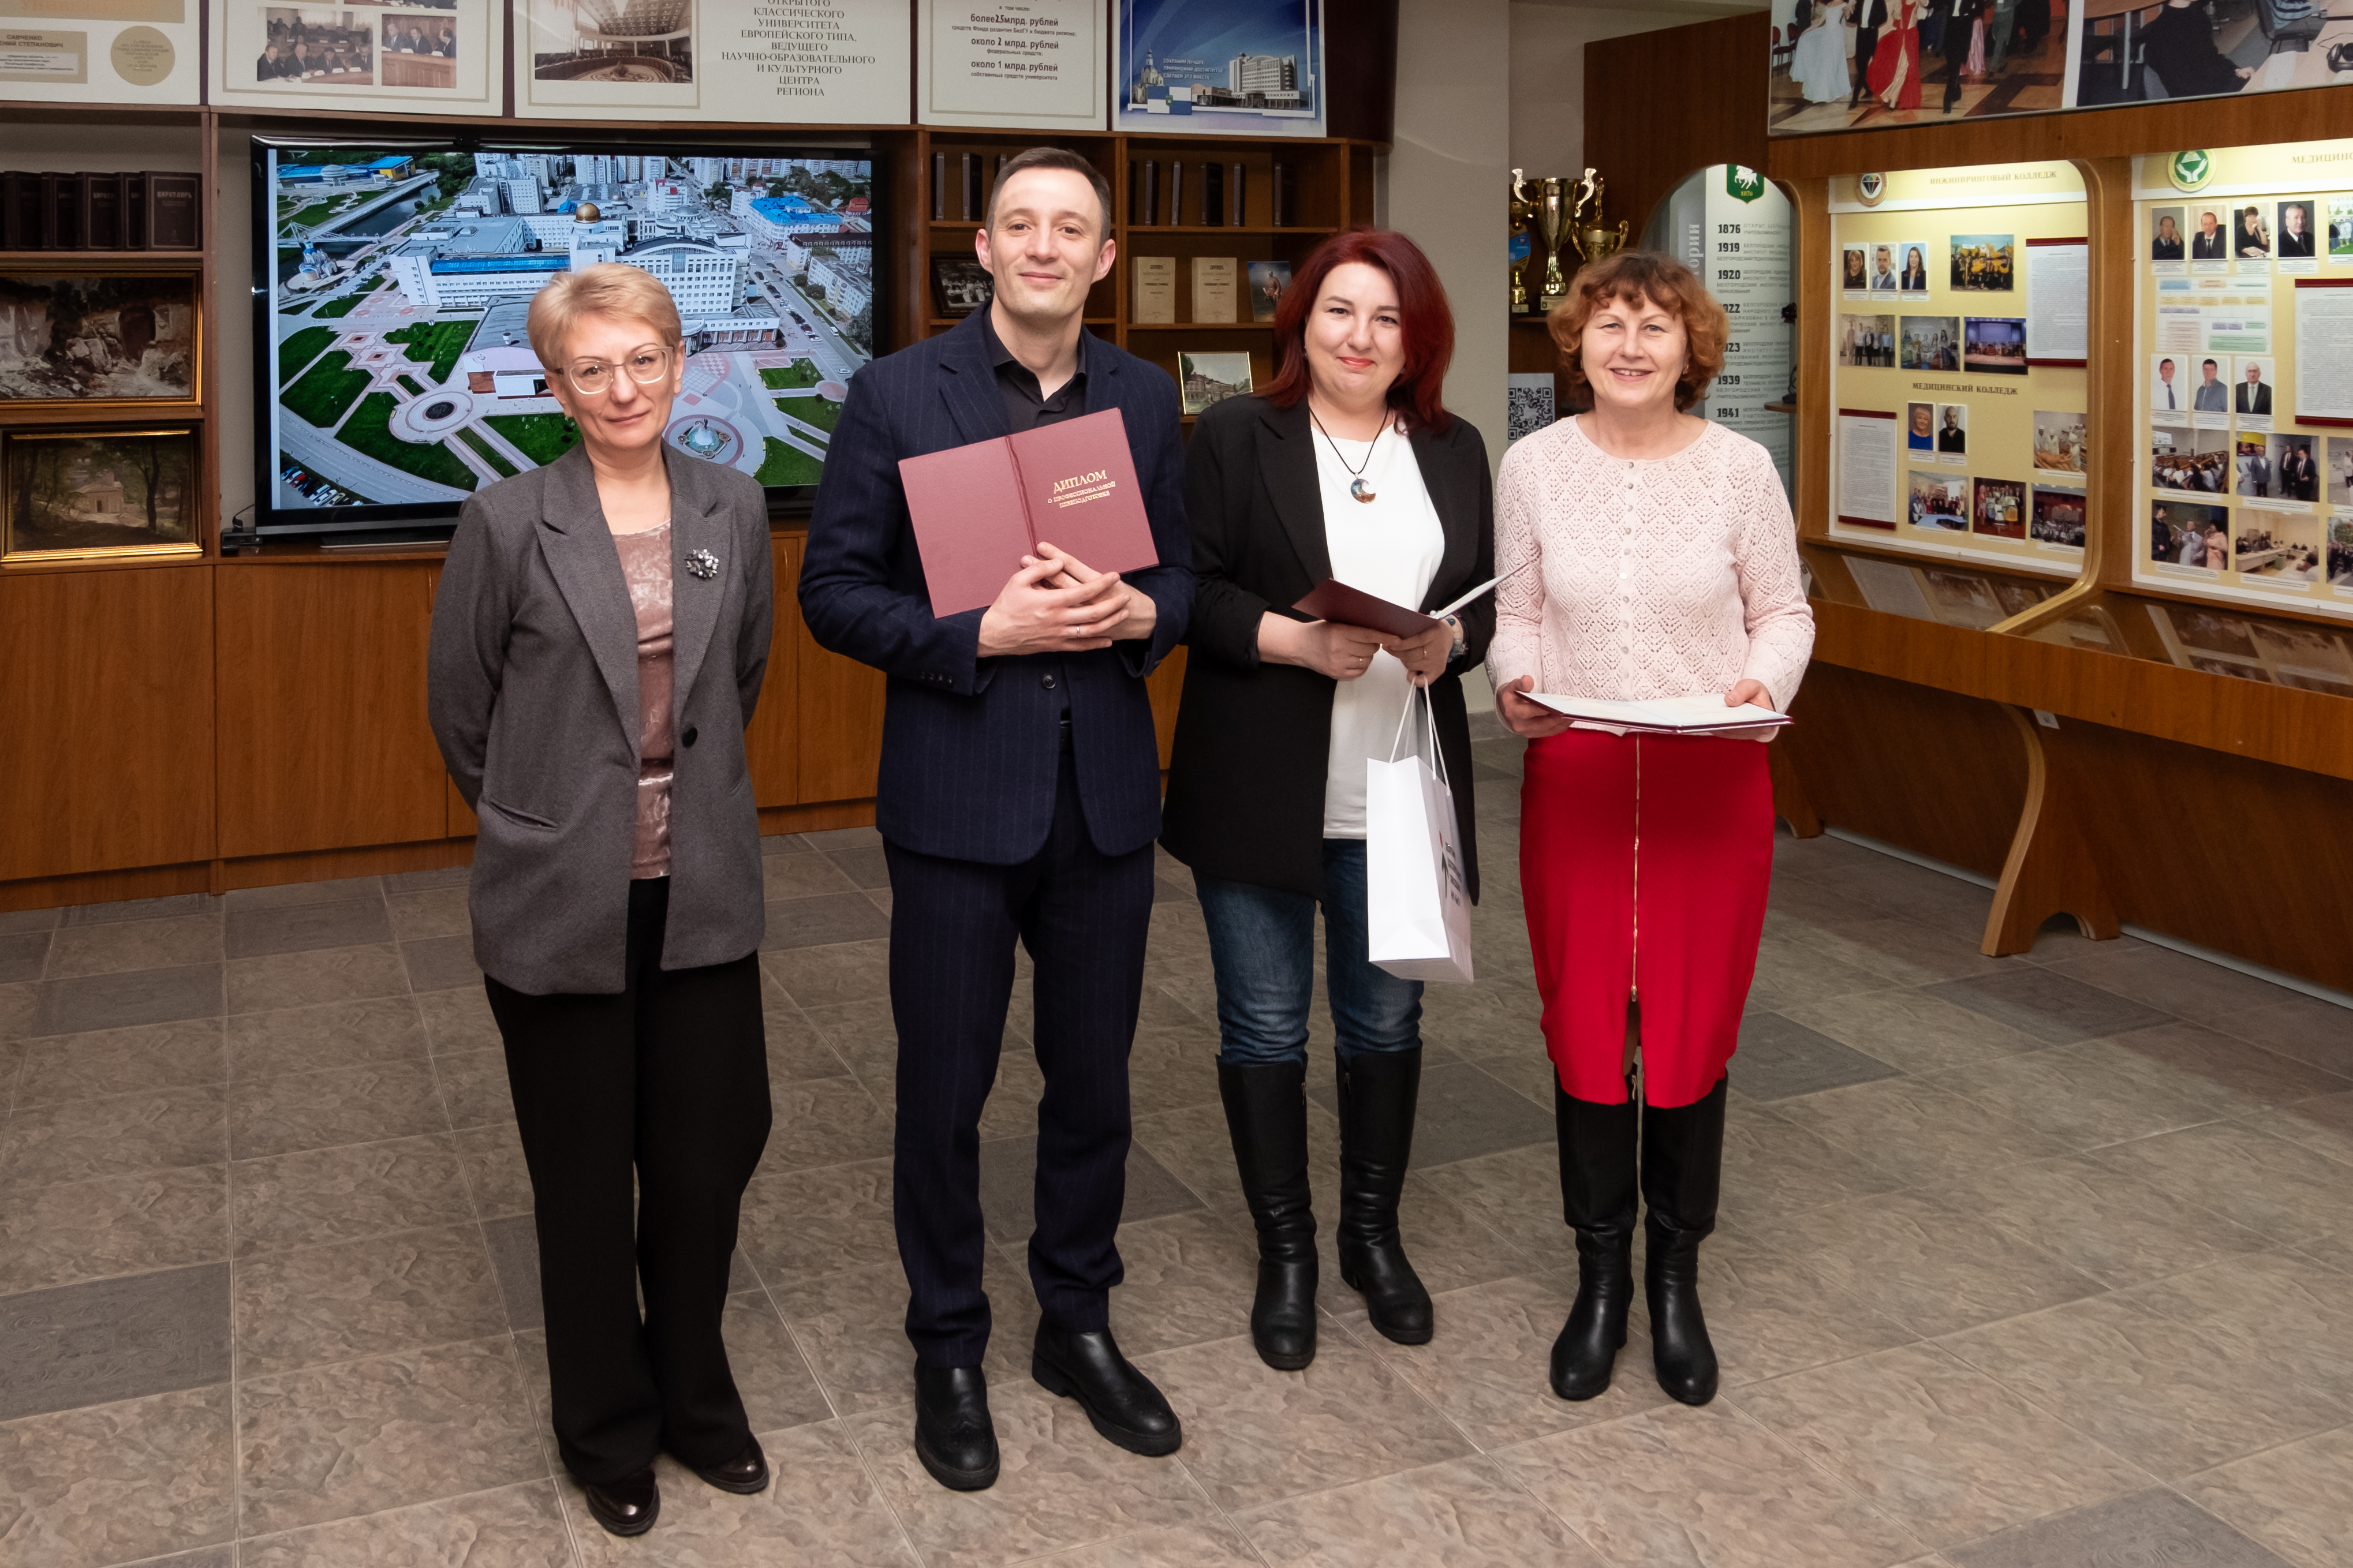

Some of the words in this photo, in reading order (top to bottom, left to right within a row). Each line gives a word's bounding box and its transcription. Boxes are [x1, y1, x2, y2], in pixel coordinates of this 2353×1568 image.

[753, 8, 845, 18] КЛАССИЧЕСКОГО
[758, 18, 840, 29] УНИВЕРСИТЕТА
[1029, 18, 1059, 27] рублей
[741, 29, 823, 40] ЕВРОПЕЙСКОГО
[771, 42, 828, 52] ВЕДУЩЕГО
[998, 37, 1002, 46] 2
[1004, 40, 1028, 48] млрд.
[1030, 40, 1059, 50] рублей
[721, 51, 876, 65] НАУЧНО-ОБРАЗОВАТЕЛЬНОГО
[757, 64, 764, 73] И
[767, 65, 842, 74] КУЛЬТУРНОГО
[998, 61, 1002, 69] 1
[1004, 63, 1028, 72] млрд.
[1029, 63, 1058, 73] рублей
[779, 76, 820, 85] ЦЕНТРА
[776, 87, 825, 96] РЕГИОНА
[1929, 173, 2011, 185] ИНЖИНИРИНГОВЫЙ
[2014, 171, 2057, 180] КОЛЛЕДЖ
[1717, 224, 1741, 234] 1876
[1717, 242, 1740, 252] 1919
[1717, 270, 1741, 279] 1920
[1723, 304, 1741, 313] 922
[1717, 375, 1740, 384] 1939
[1912, 383, 1973, 392] МЕДИЦИНСКИЙ
[1976, 386, 2018, 395] КОЛЛЕДЖ
[1717, 407, 1739, 417] 1941
[1054, 469, 1108, 494] ДИПЛОМ
[1054, 481, 1116, 503] ПРОФЕССИОНАЛЬНОЙ
